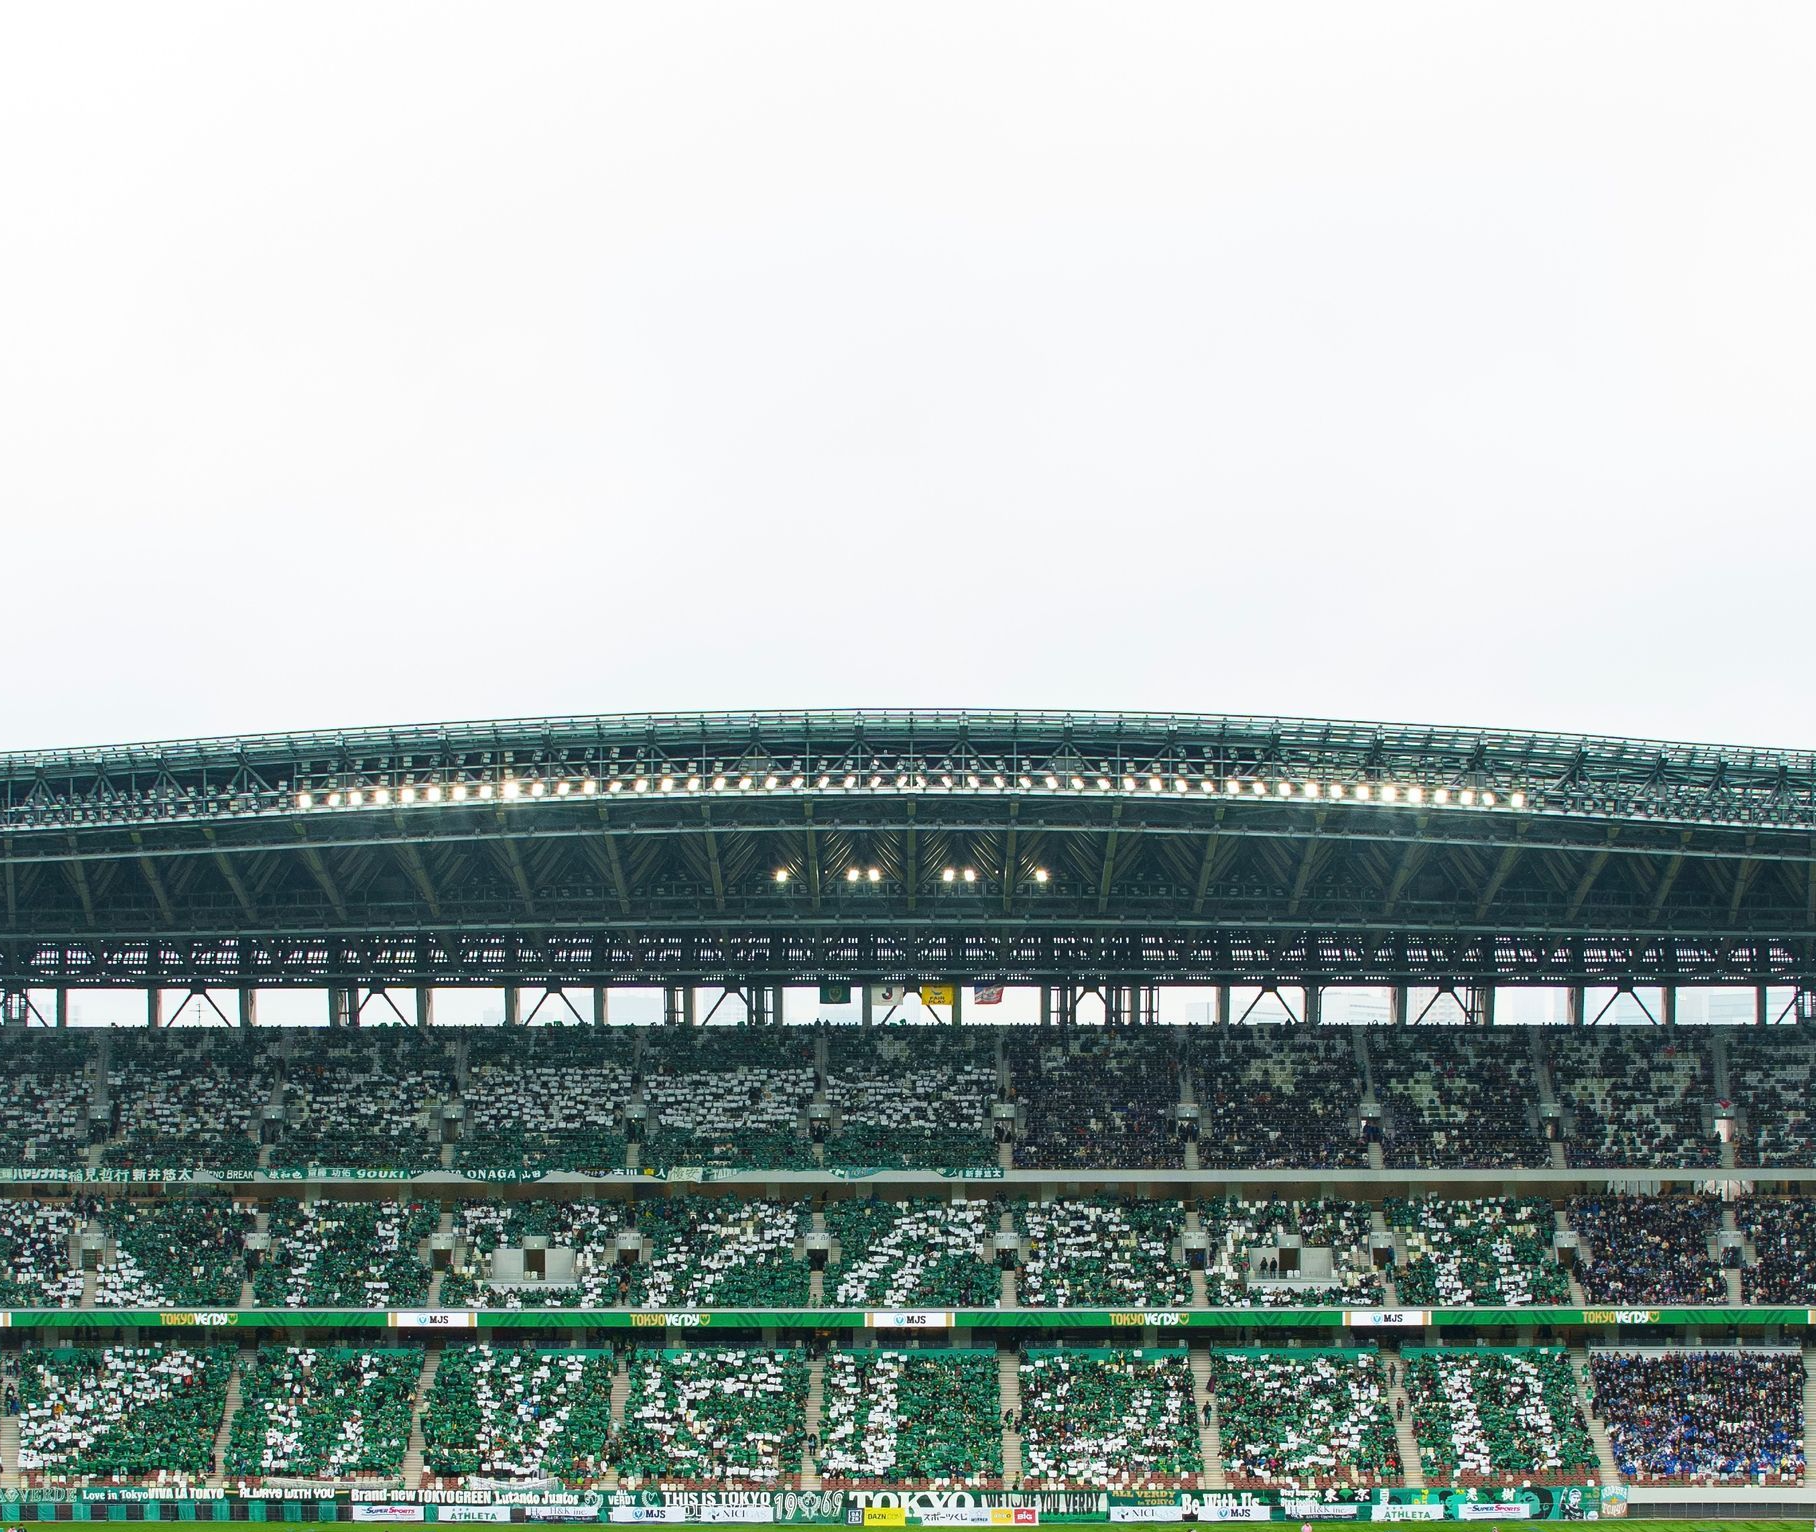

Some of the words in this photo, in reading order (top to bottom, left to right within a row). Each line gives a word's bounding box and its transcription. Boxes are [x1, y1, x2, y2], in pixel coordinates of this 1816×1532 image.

[133, 1168, 194, 1182] 新井悠太
[227, 1169, 254, 1179] BREAK
[467, 1170, 517, 1180] ONAGA
[429, 1315, 449, 1326] MJS
[906, 1314, 927, 1326] MJS
[1383, 1312, 1404, 1323] MJS
[82, 1489, 106, 1501] Love
[107, 1489, 118, 1501] in
[119, 1489, 149, 1503] Tokyo
[148, 1488, 174, 1500] VIVA
[175, 1488, 188, 1500] LA
[190, 1488, 225, 1500] TOKYO
[284, 1488, 312, 1500] WITH
[312, 1488, 335, 1500] YOU
[351, 1489, 417, 1502] Brand-new
[494, 1491, 541, 1505] Lutando
[542, 1491, 580, 1506] Juntos
[663, 1491, 698, 1506] THIS
[701, 1491, 716, 1506] IS
[720, 1491, 771, 1506] TOKYO
[1112, 1490, 1133, 1498] ALL
[1136, 1490, 1176, 1498] VERDY
[607, 1495, 637, 1507] VERDY
[849, 1490, 975, 1517] TOKYO
[1182, 1493, 1199, 1514] Be
[1231, 1509, 1251, 1517] MJS
[1495, 1504, 1520, 1512] SPORTS
[451, 1510, 498, 1521] ATHLETA
[646, 1510, 666, 1519] MJS
[924, 1512, 968, 1522] スポーツくじ
[1017, 1511, 1033, 1521] BIG
[1384, 1510, 1431, 1519] ATHLETA
